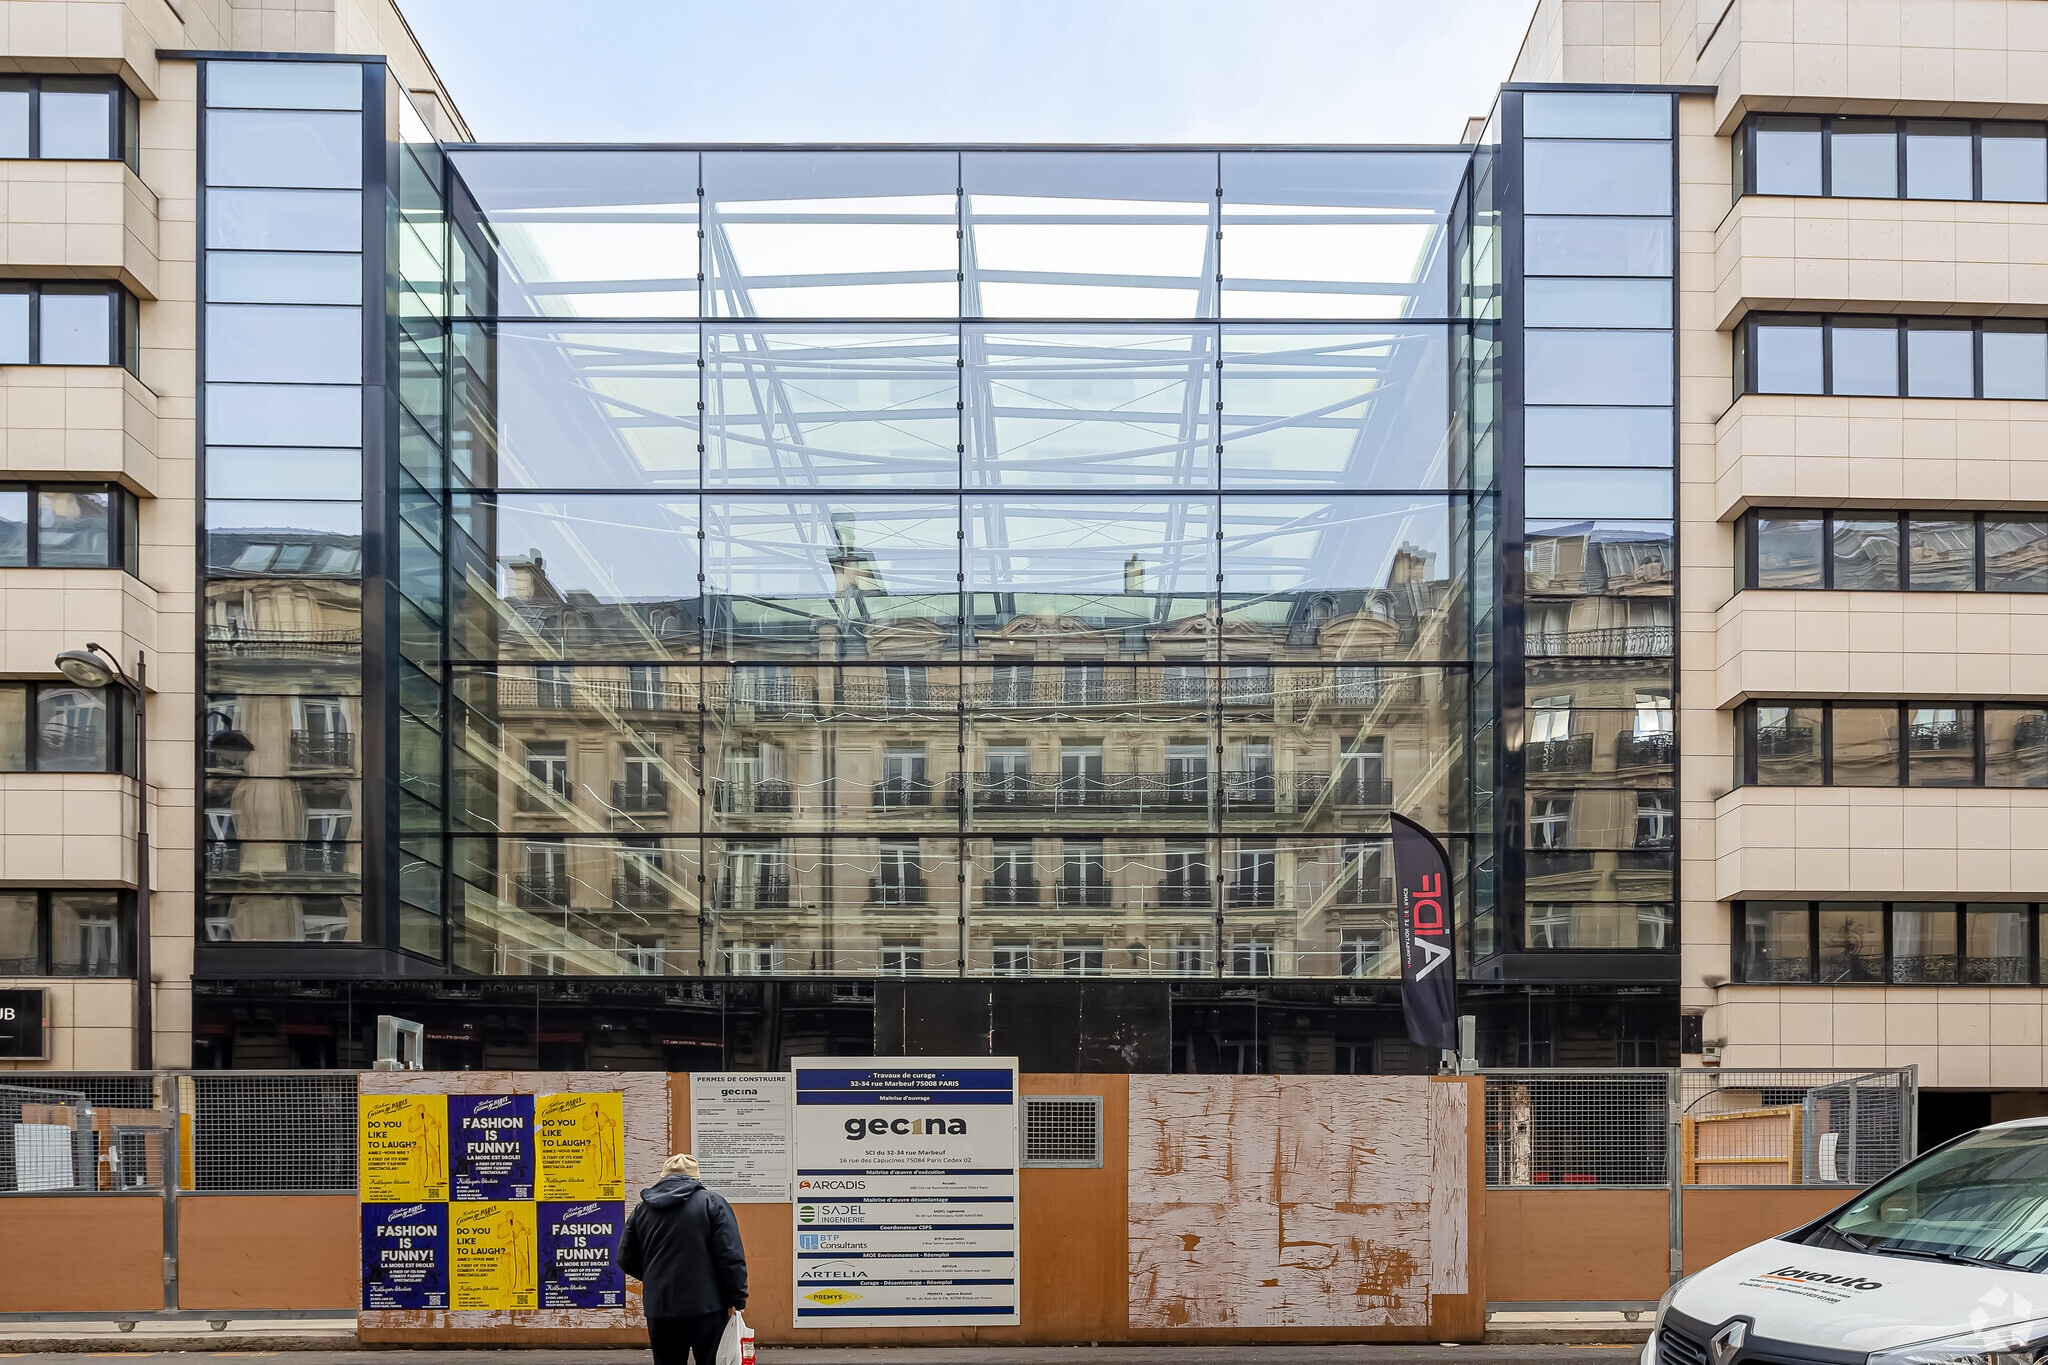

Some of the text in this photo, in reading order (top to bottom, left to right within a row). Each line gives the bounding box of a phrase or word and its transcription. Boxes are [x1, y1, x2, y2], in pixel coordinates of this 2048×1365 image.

[463, 1117, 523, 1128] FASHION
[485, 1130, 497, 1141] IS
[467, 1142, 520, 1153] FUNNY!
[812, 1181, 865, 1189] ARCADIS
[822, 1205, 866, 1215] SADEL
[377, 1225, 437, 1236] FASHION
[552, 1224, 612, 1235] FASHION
[399, 1238, 411, 1249] IS
[574, 1237, 586, 1247] IS
[821, 1240, 867, 1249] Consultants
[381, 1250, 433, 1261] FUNNY!
[556, 1249, 608, 1260] FUNNY!
[1768, 1266, 1882, 1290] lovauto
